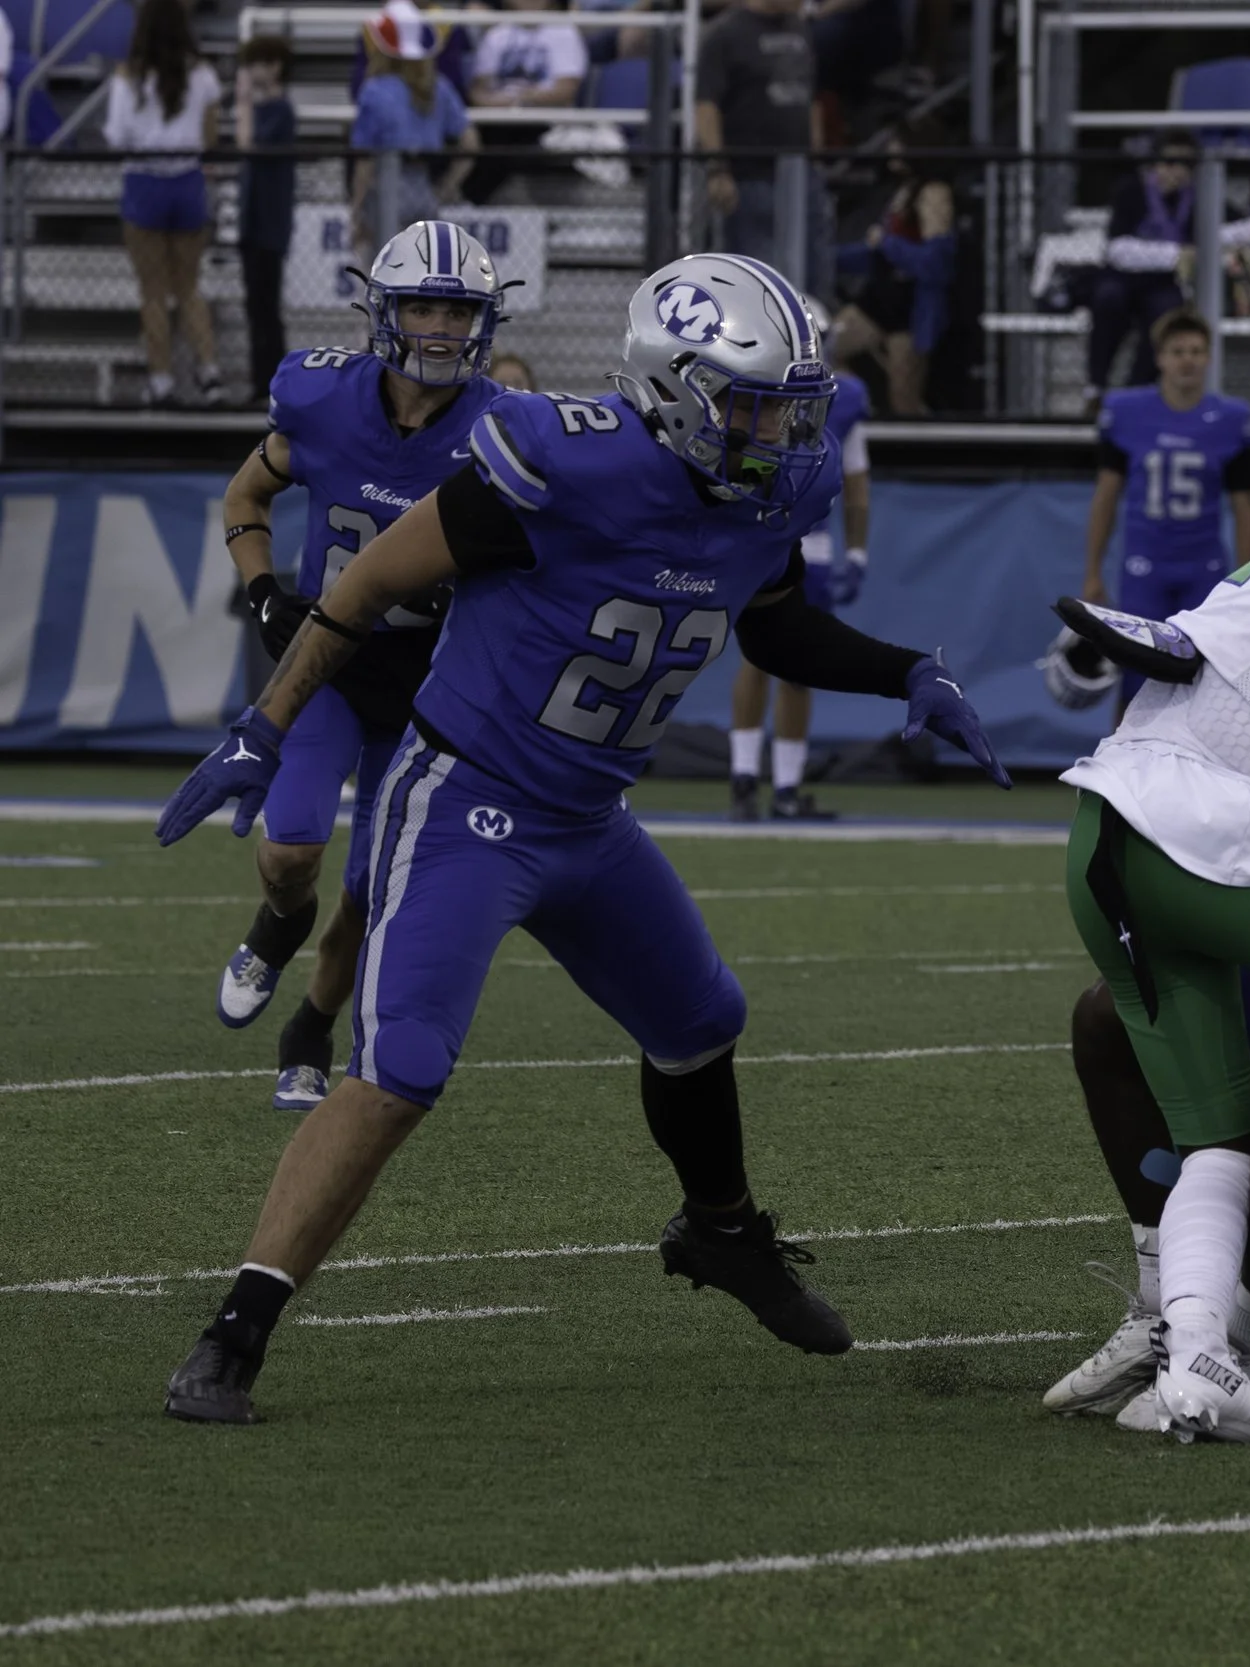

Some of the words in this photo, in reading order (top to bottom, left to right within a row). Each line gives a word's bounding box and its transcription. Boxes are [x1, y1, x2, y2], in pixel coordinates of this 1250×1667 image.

[658, 285, 721, 343] M
[1144, 449, 1206, 521] 15
[654, 569, 717, 596] Vikings
[537, 596, 730, 749] 22
[473, 809, 508, 837] M
[1188, 1352, 1244, 1397] NIKE
